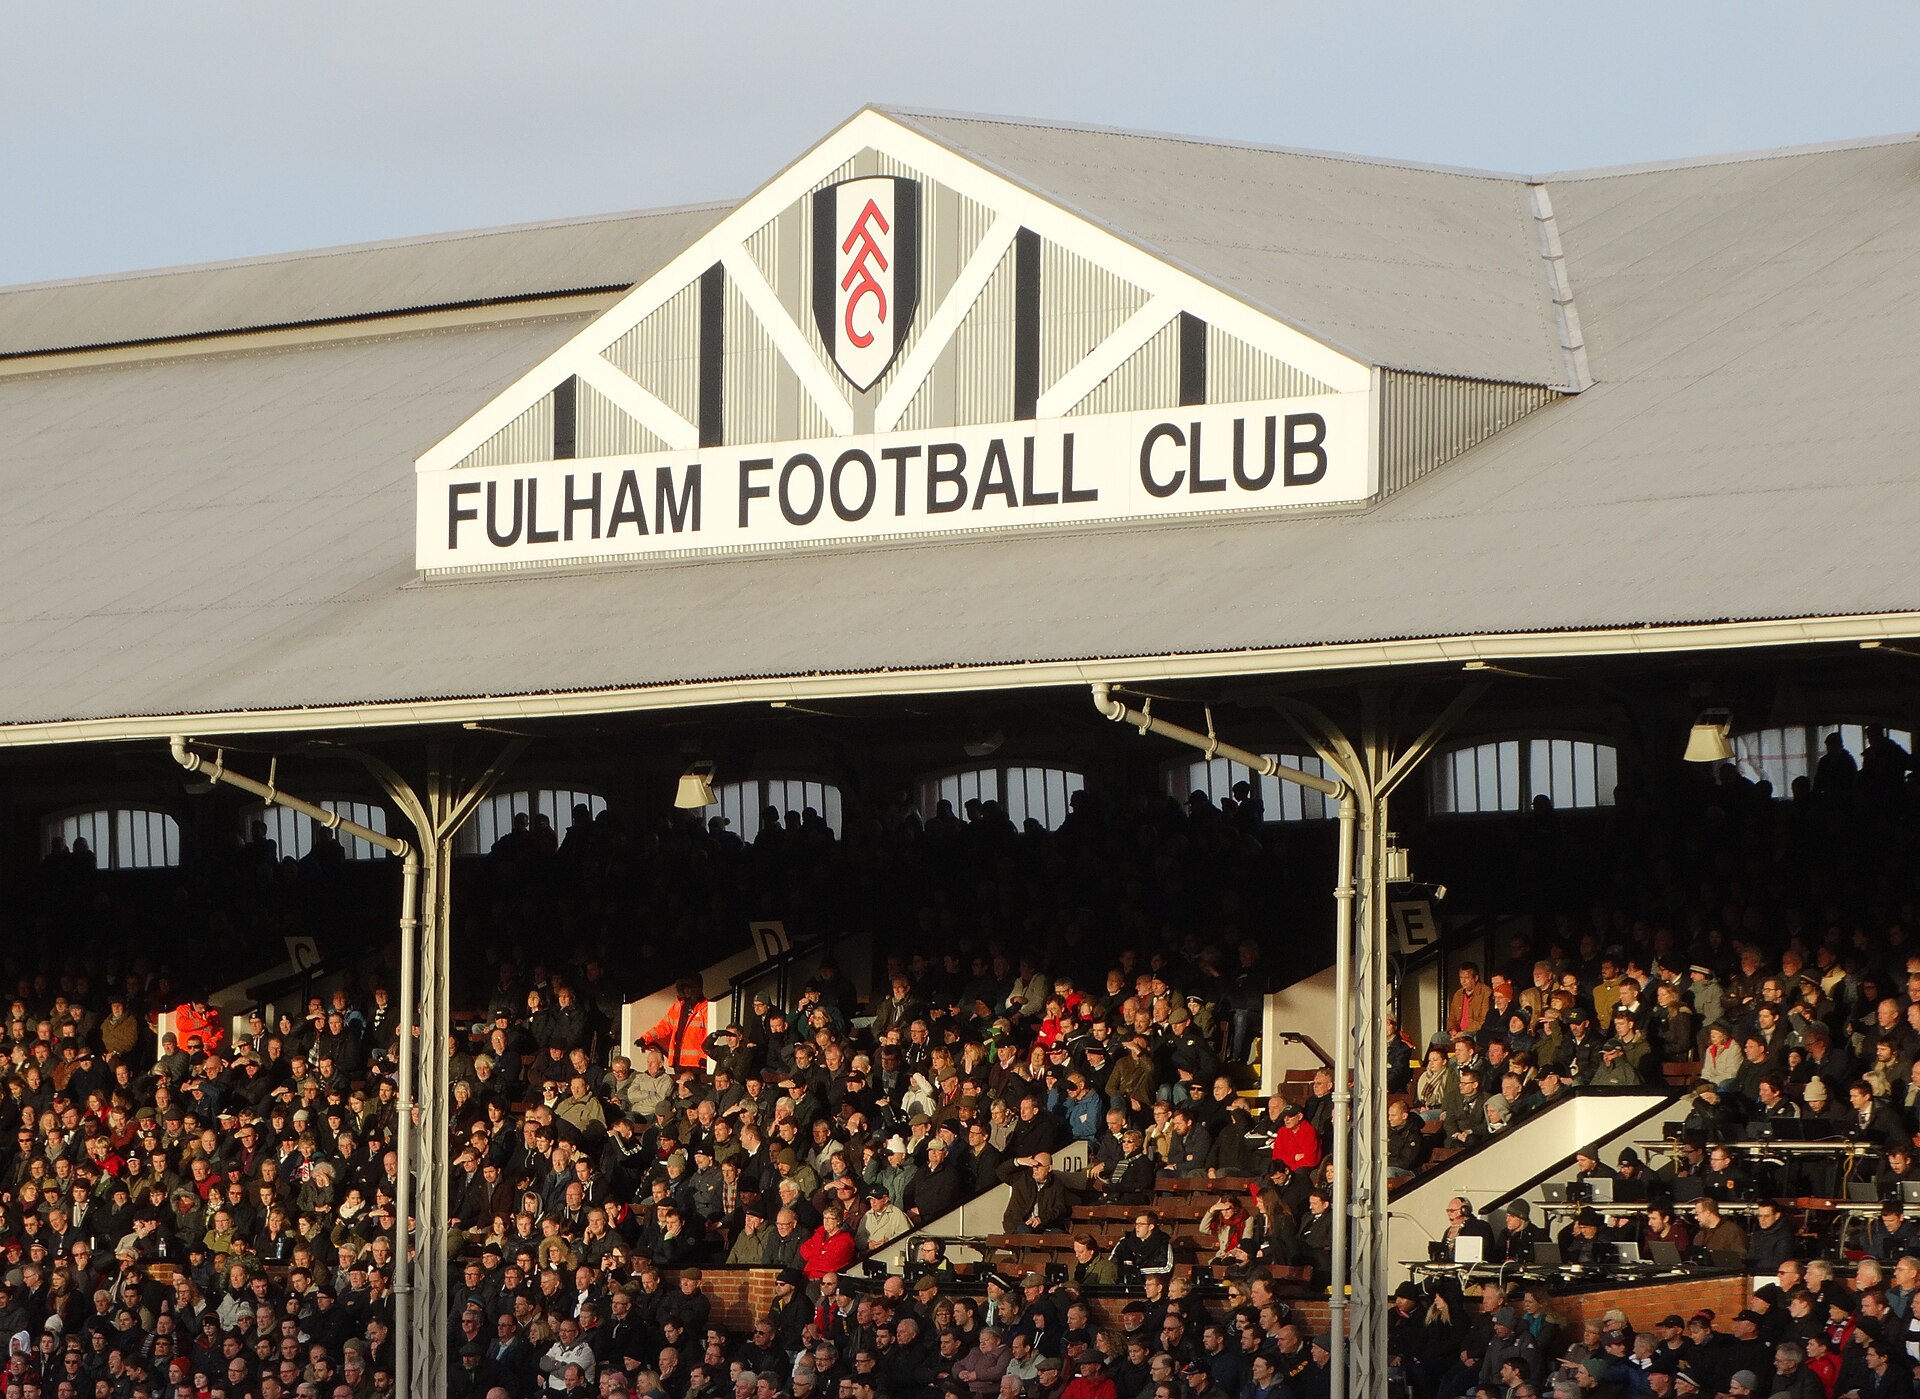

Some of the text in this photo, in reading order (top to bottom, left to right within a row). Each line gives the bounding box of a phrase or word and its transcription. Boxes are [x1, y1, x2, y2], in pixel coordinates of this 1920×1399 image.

[448, 412, 1328, 550] FULHAM FOOTBALL CLUB
[1402, 909, 1428, 945] E
[295, 943, 313, 971] C
[759, 929, 783, 959] D
